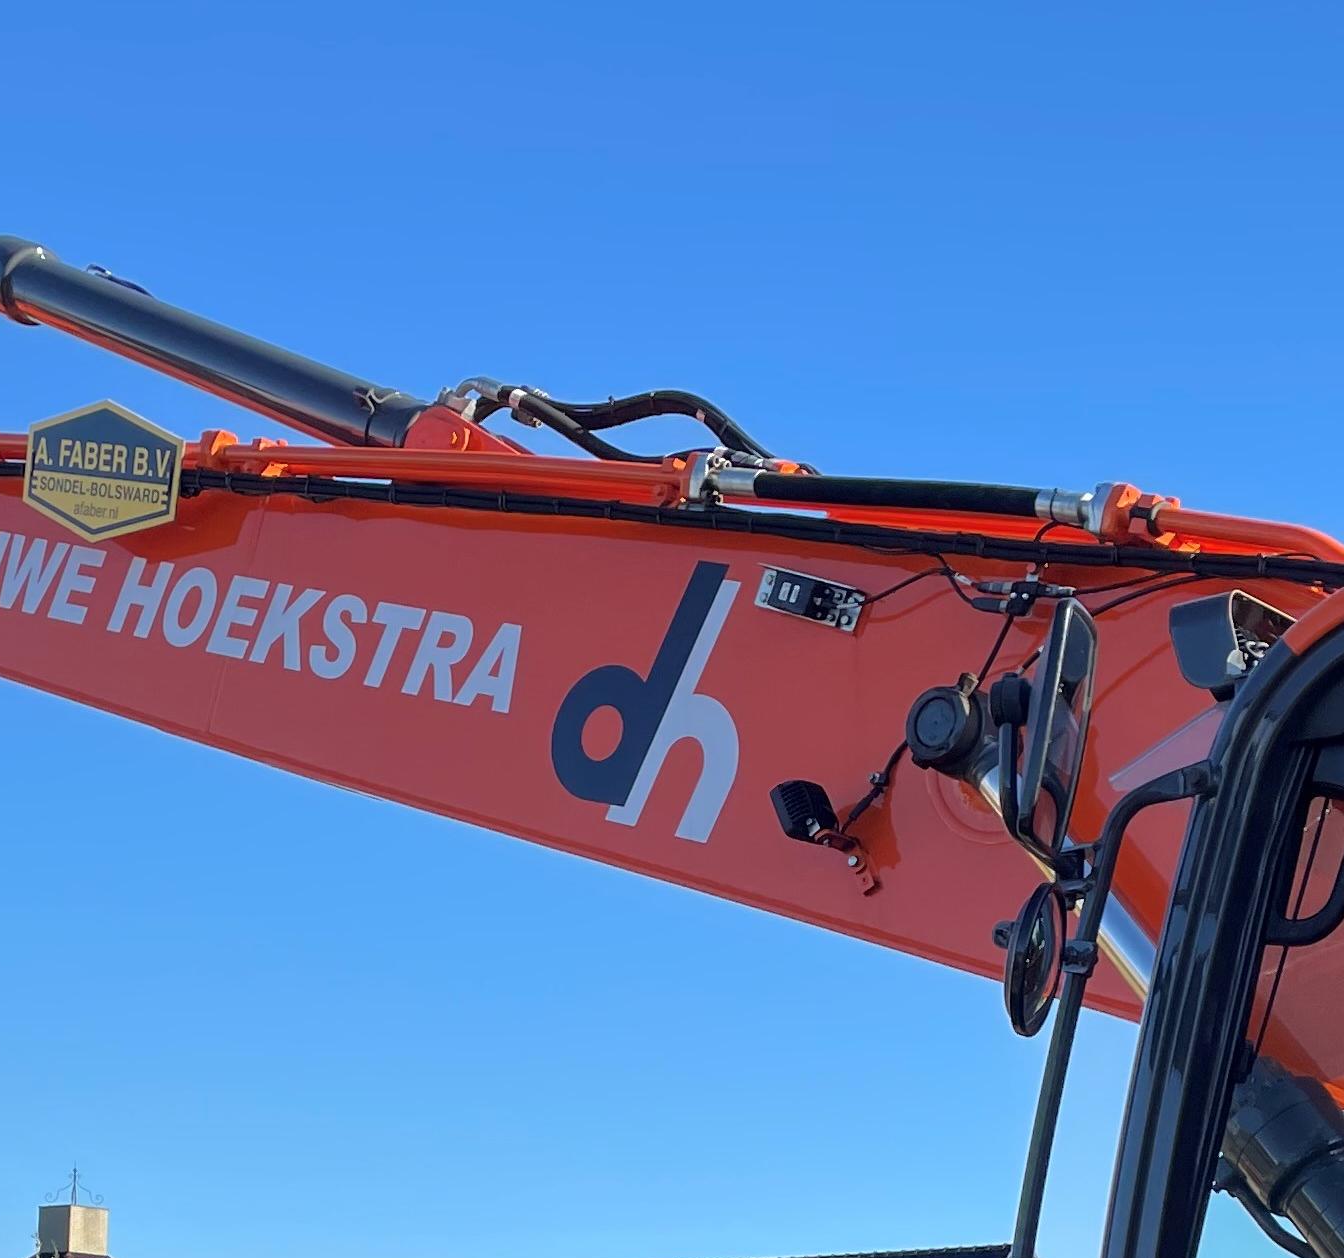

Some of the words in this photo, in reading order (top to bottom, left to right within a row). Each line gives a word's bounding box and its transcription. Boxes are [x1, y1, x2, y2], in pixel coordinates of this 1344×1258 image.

[35, 437, 53, 465] A.
[58, 439, 128, 474] FABER
[40, 476, 160, 504] SONDEL-BOLSWARD
[73, 502, 119, 520] afaber.nl
[106, 556, 522, 714] HOEKSTRA
